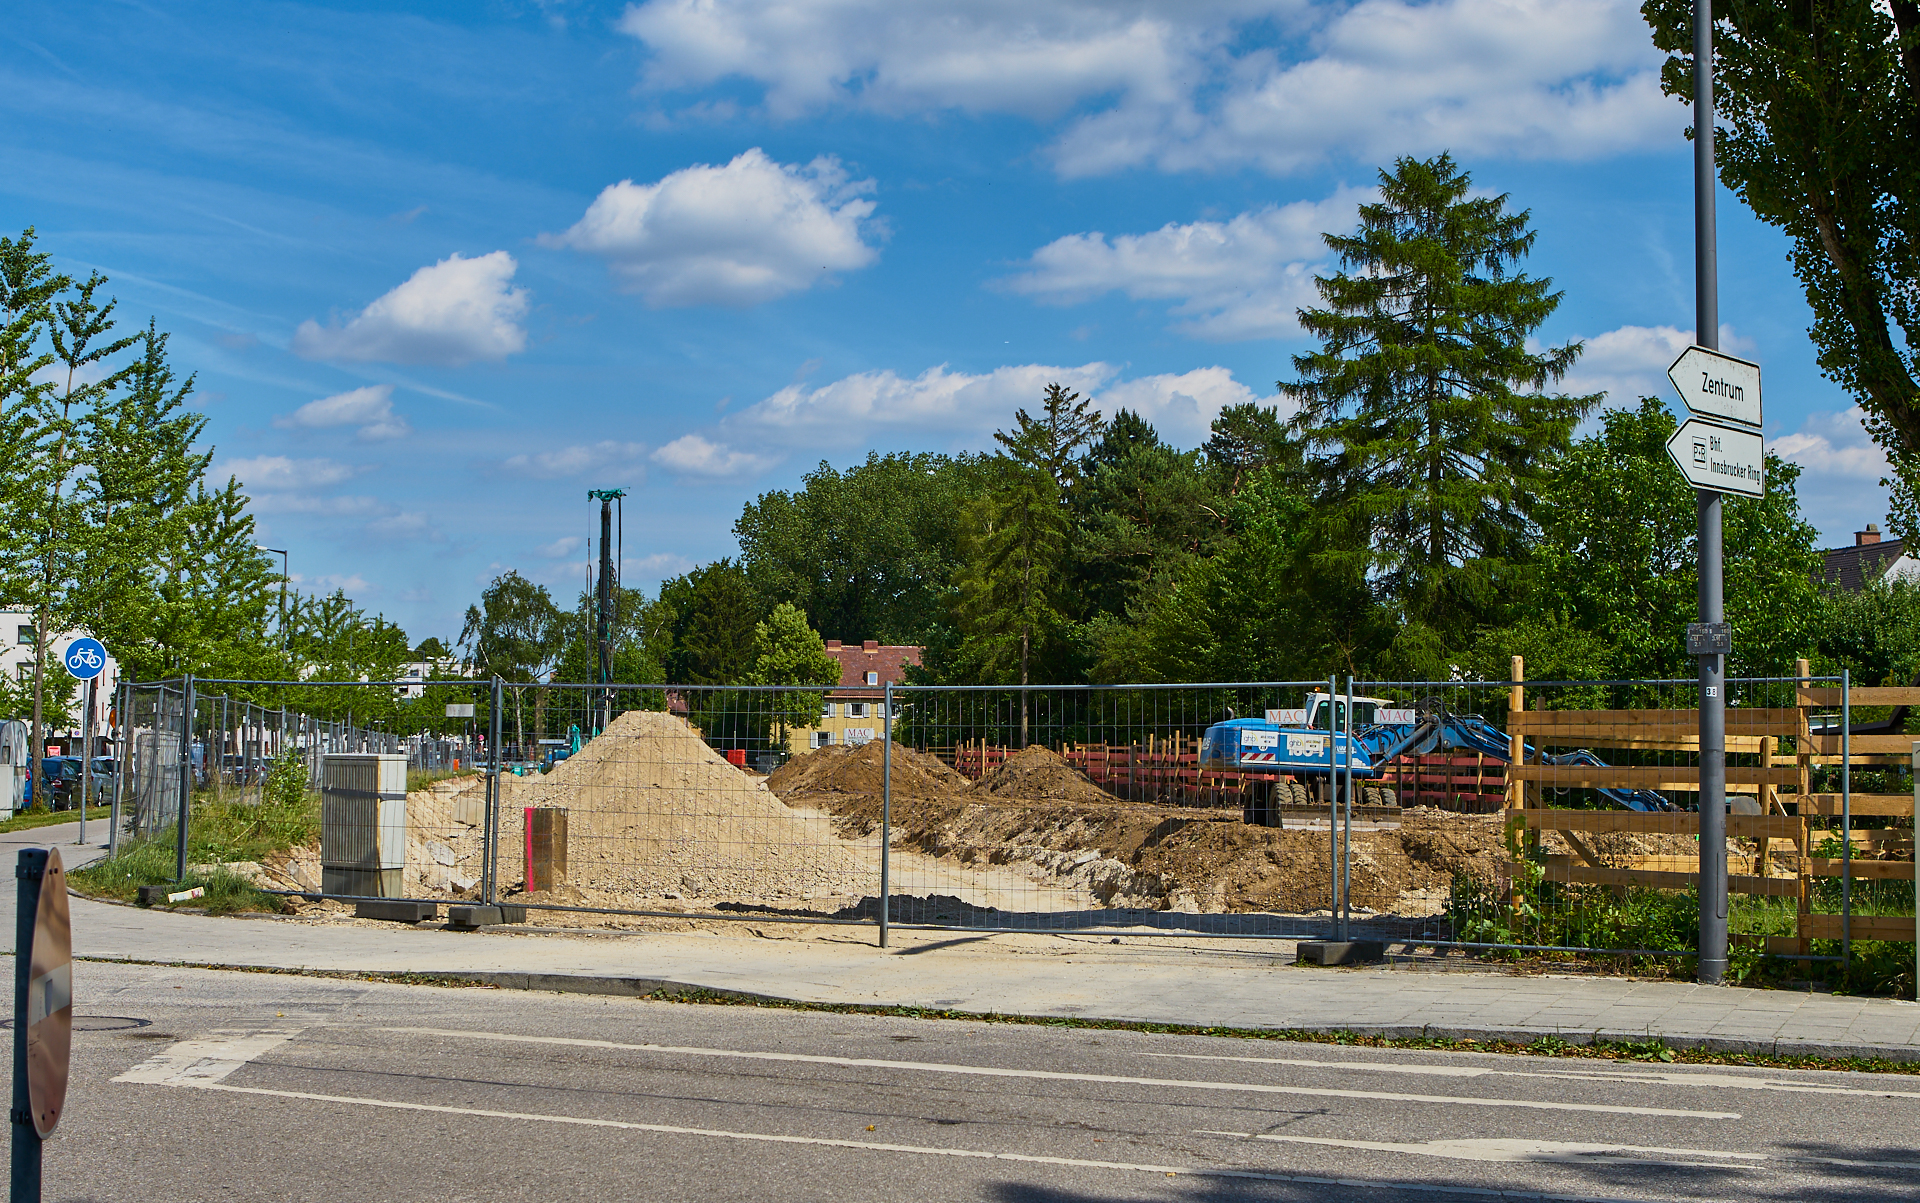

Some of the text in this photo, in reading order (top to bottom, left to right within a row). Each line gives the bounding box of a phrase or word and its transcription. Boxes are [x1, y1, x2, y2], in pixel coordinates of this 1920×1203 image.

[1702, 371, 1744, 402] Zentrum
[1709, 435, 1723, 453] Bhf.
[1710, 457, 1760, 486] Innsbrucker Ring
[1269, 709, 1304, 722] MAC
[1379, 709, 1413, 722] MAC
[848, 728, 870, 737] MAC
